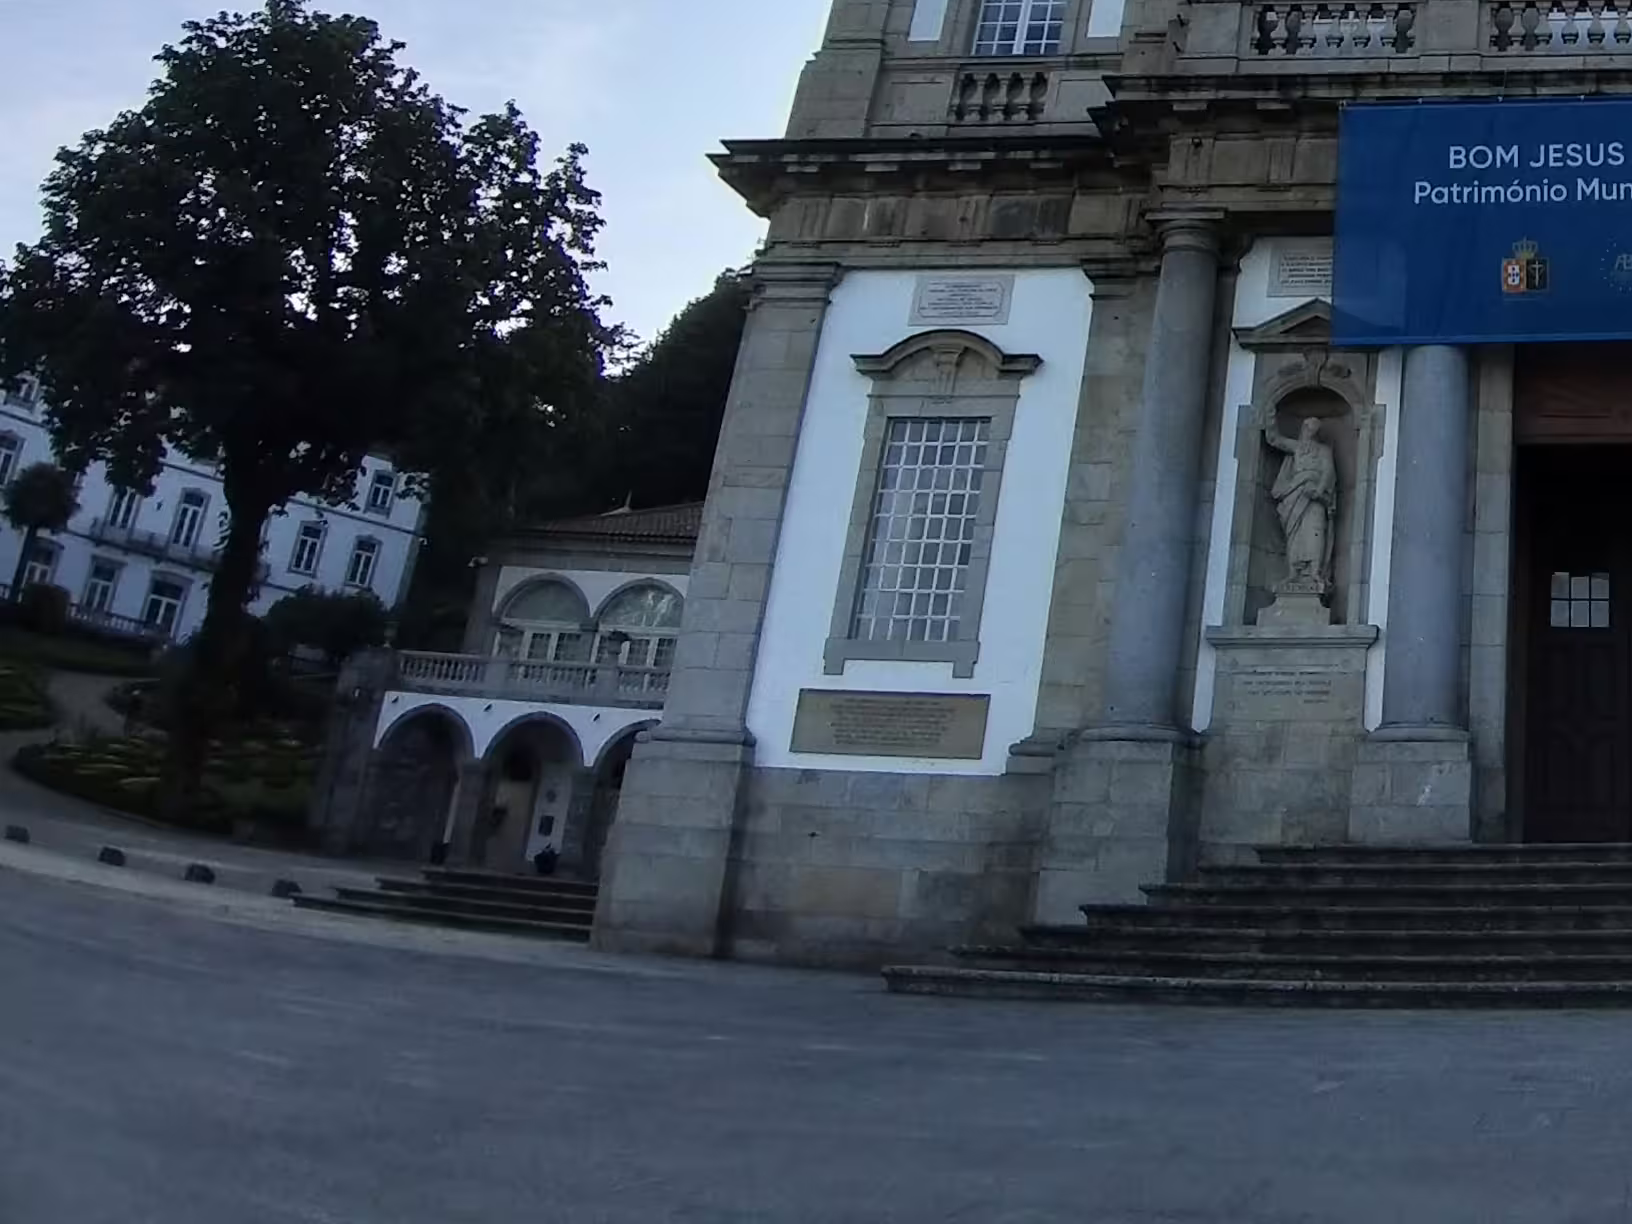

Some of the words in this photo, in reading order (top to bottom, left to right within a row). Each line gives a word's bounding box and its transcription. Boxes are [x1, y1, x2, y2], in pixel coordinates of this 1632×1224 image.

[1449, 144, 1519, 169] BOM
[1529, 142, 1625, 168] JESUS
[1414, 178, 1568, 205] Património
